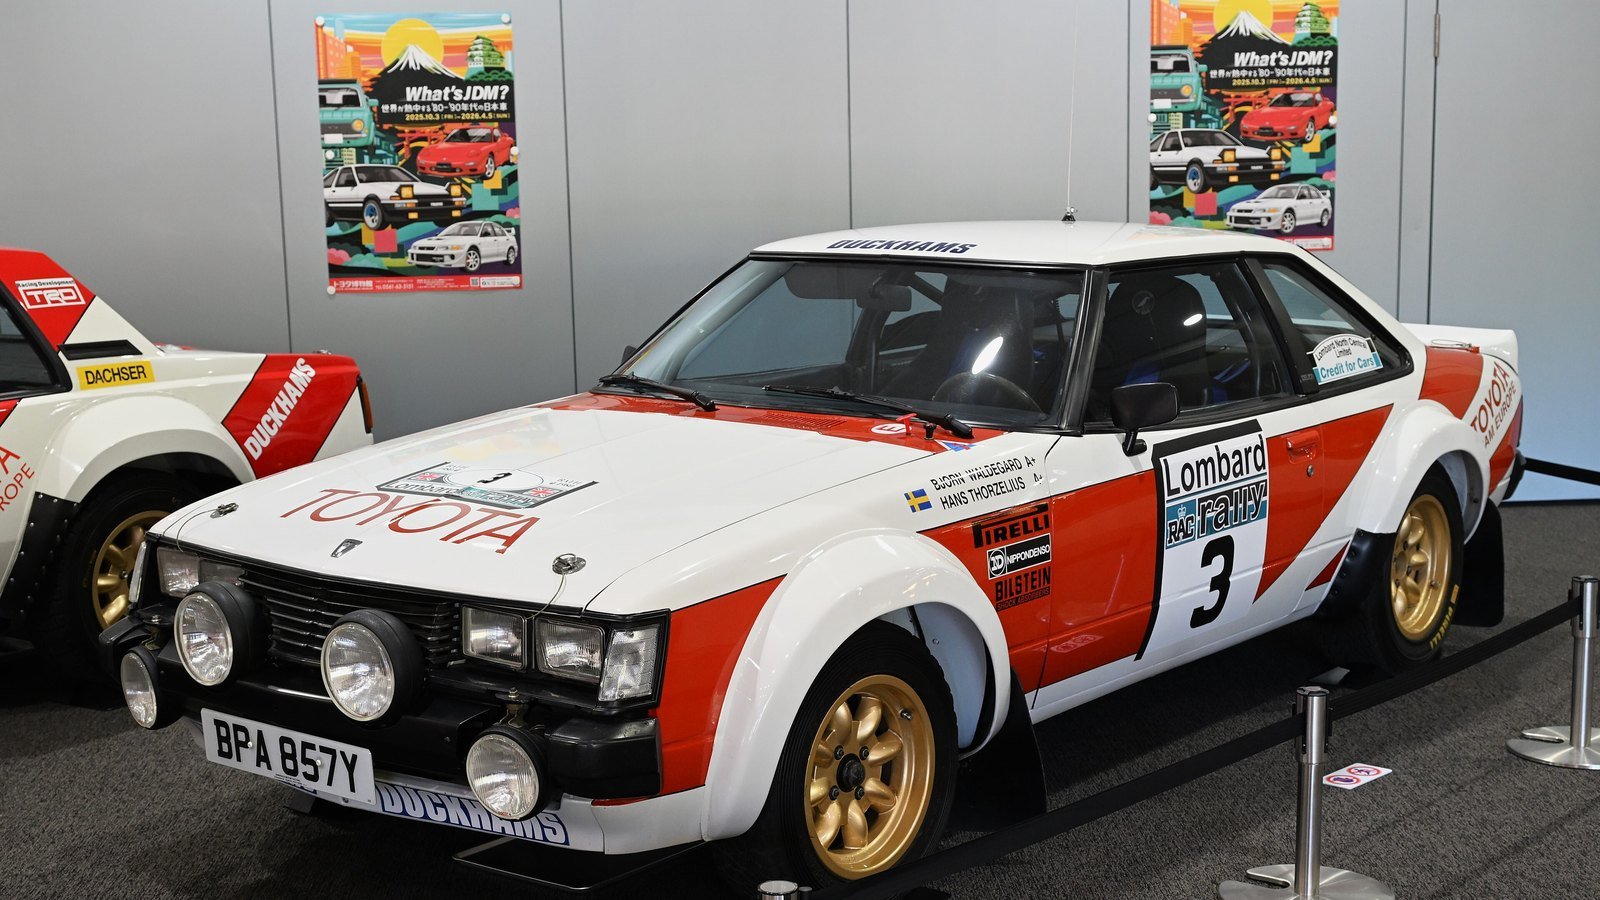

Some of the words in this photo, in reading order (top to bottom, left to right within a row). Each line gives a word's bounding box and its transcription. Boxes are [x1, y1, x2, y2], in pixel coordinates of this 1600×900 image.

[1234, 51, 1289, 67] What's
[1289, 50, 1333, 66] JDM?
[405, 85, 463, 101] What's
[463, 85, 510, 101] JDM?
[826, 239, 978, 254] DUCKHAMS
[25, 287, 79, 305] TRD
[1315, 341, 1336, 361] Lombard
[1335, 338, 1349, 348] North
[1334, 347, 1353, 358] Limited
[85, 365, 147, 385] DACHSER
[1320, 364, 1345, 379] Credit
[1345, 360, 1356, 371] for
[1357, 357, 1374, 369] Cars
[243, 357, 317, 461] DUCKHAMS
[1470, 361, 1510, 433] TOYOTA
[1494, 380, 1517, 430] EUROPE
[1163, 434, 1266, 497] Lombard
[940, 491, 969, 510] HANS
[968, 476, 1026, 502] THORZELIUS
[1199, 481, 1266, 538] rally
[279, 488, 541, 554] TOYOTA
[972, 503, 1050, 550] PIRELLI
[1166, 515, 1195, 545] RAC
[1006, 544, 1051, 566] NIPPONDENSO
[995, 566, 1051, 602] BILSTEIN
[1189, 534, 1235, 629] 3
[213, 718, 273, 771] BPA
[279, 735, 358, 793] 857Y
